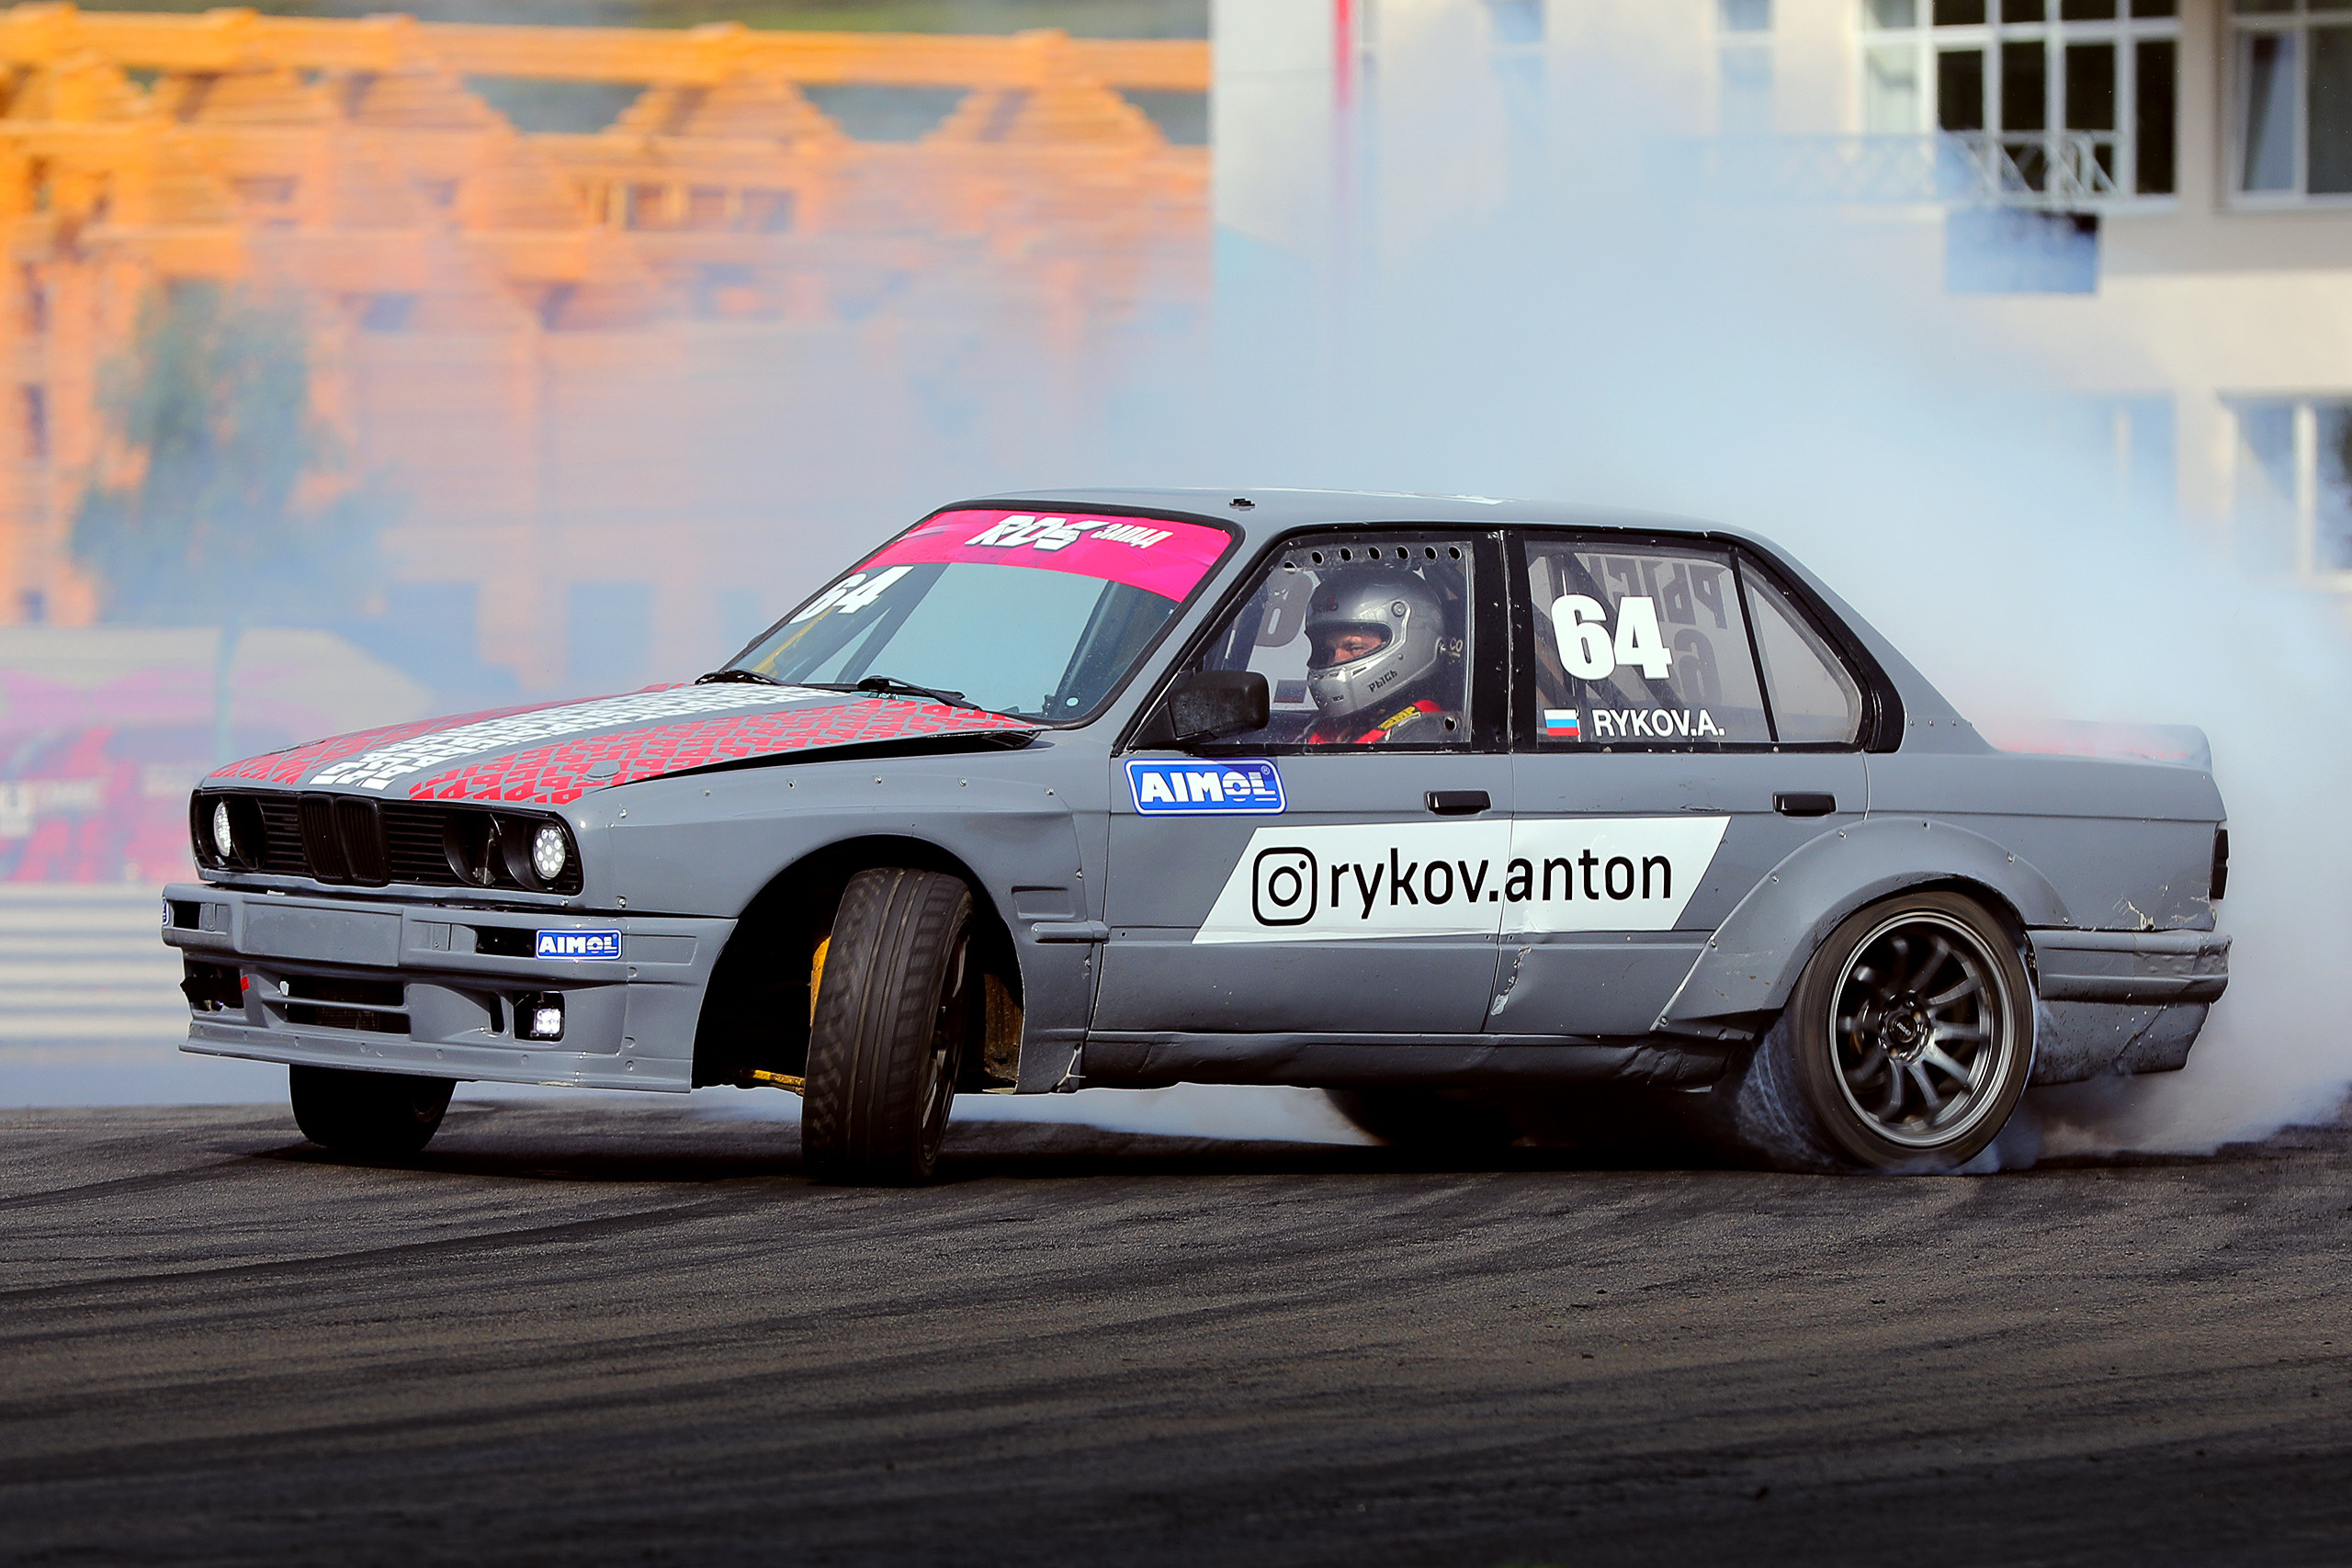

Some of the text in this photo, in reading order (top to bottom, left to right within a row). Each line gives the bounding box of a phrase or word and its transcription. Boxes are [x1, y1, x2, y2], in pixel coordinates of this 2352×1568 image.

[788, 565, 915, 625] 64
[1551, 593, 1674, 682] 64
[1140, 771, 1278, 803] AIMOL
[1330, 847, 1672, 919] rykov.anton
[538, 936, 618, 953] AIMOL
